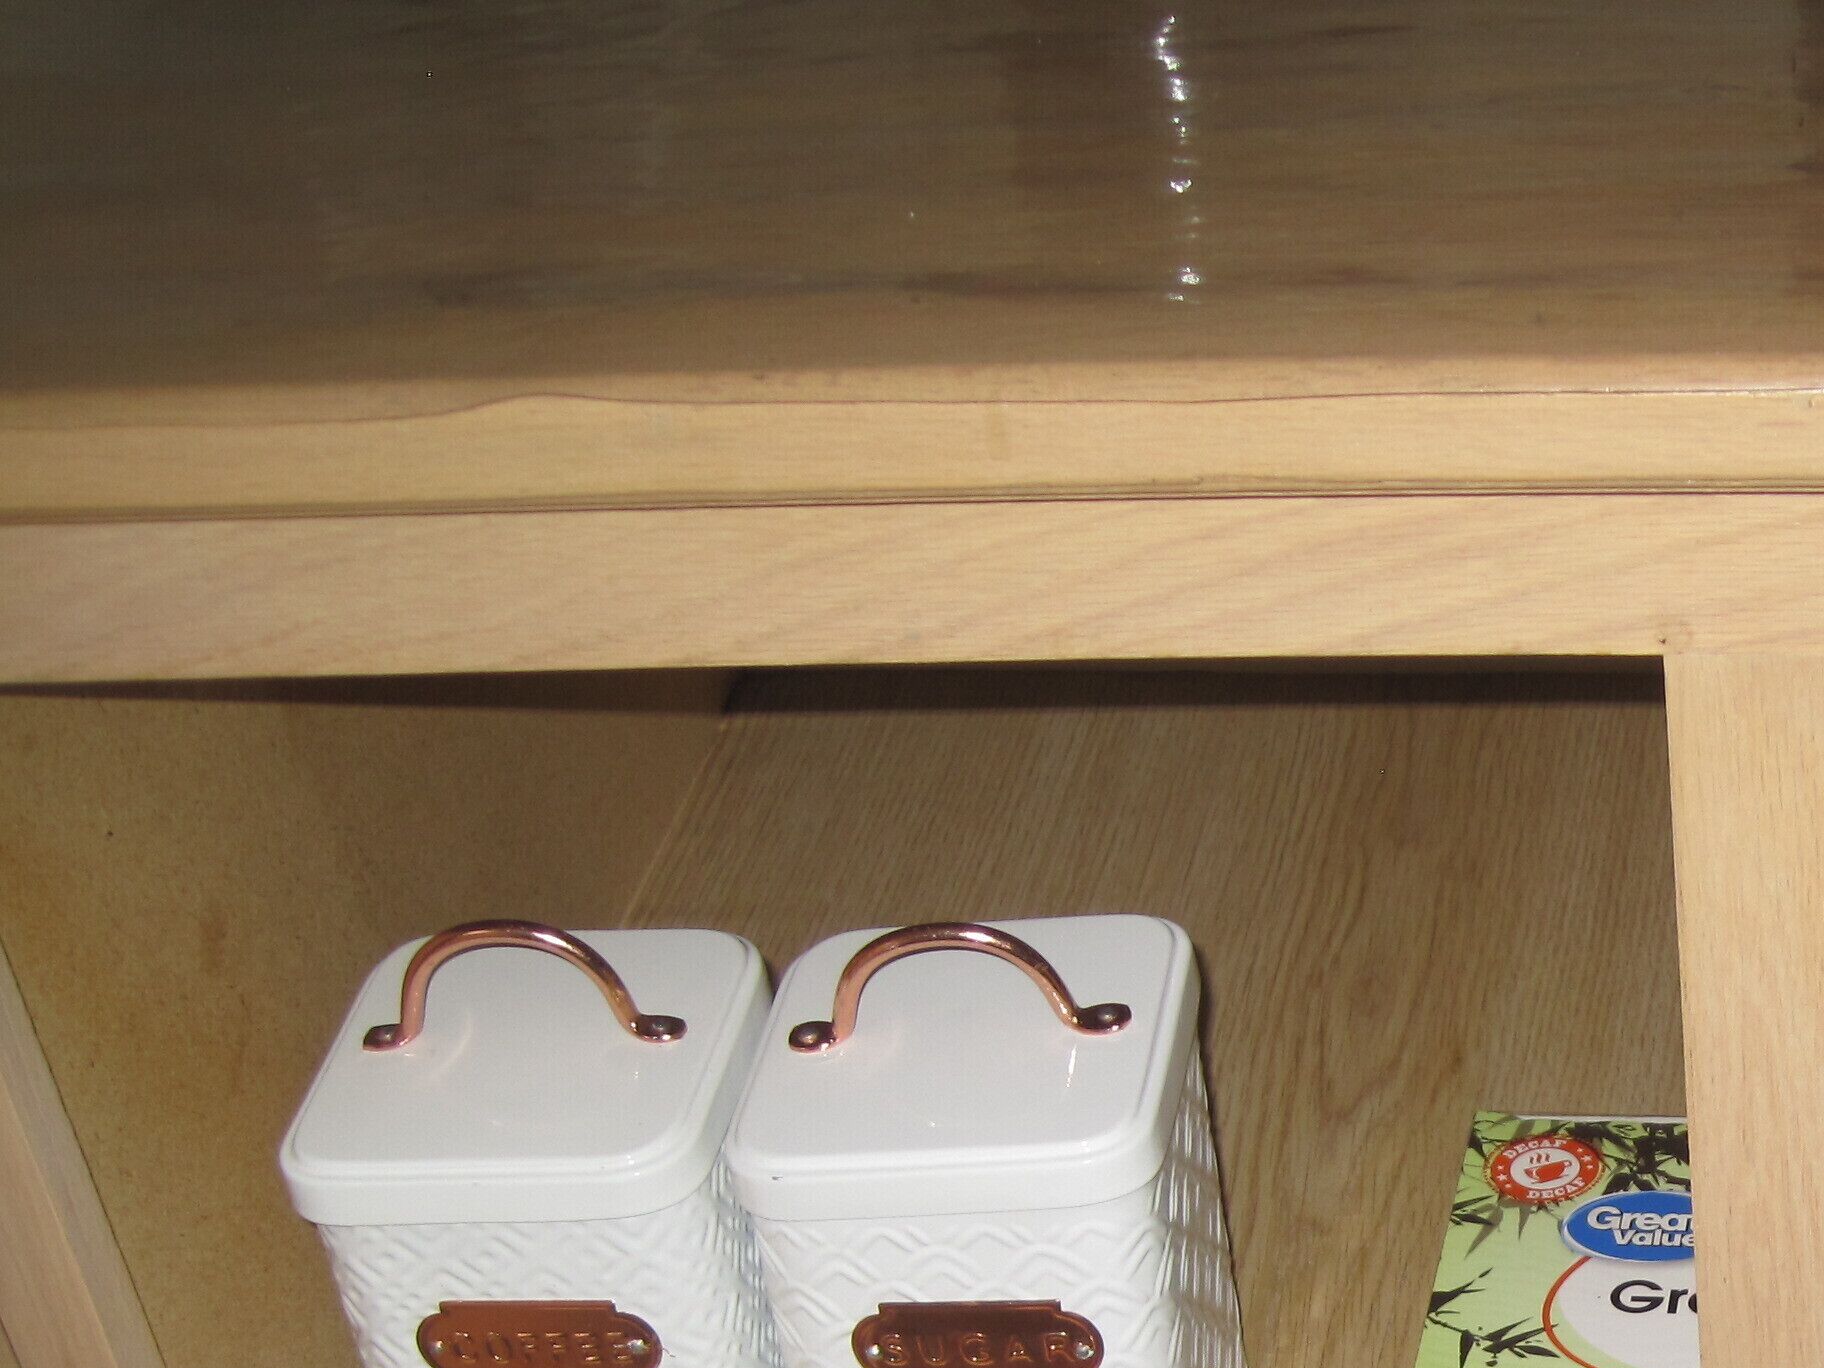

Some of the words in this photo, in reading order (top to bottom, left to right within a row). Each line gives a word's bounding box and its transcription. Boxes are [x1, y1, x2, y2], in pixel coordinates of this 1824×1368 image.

[1505, 1139, 1567, 1158] DECAF
[1526, 1176, 1586, 1199] DECAF
[1587, 1205, 1693, 1231] Grea
[1610, 1280, 1697, 1314] Gr
[452, 1331, 632, 1364] COFFEE
[879, 1332, 1075, 1366] SUGAR
